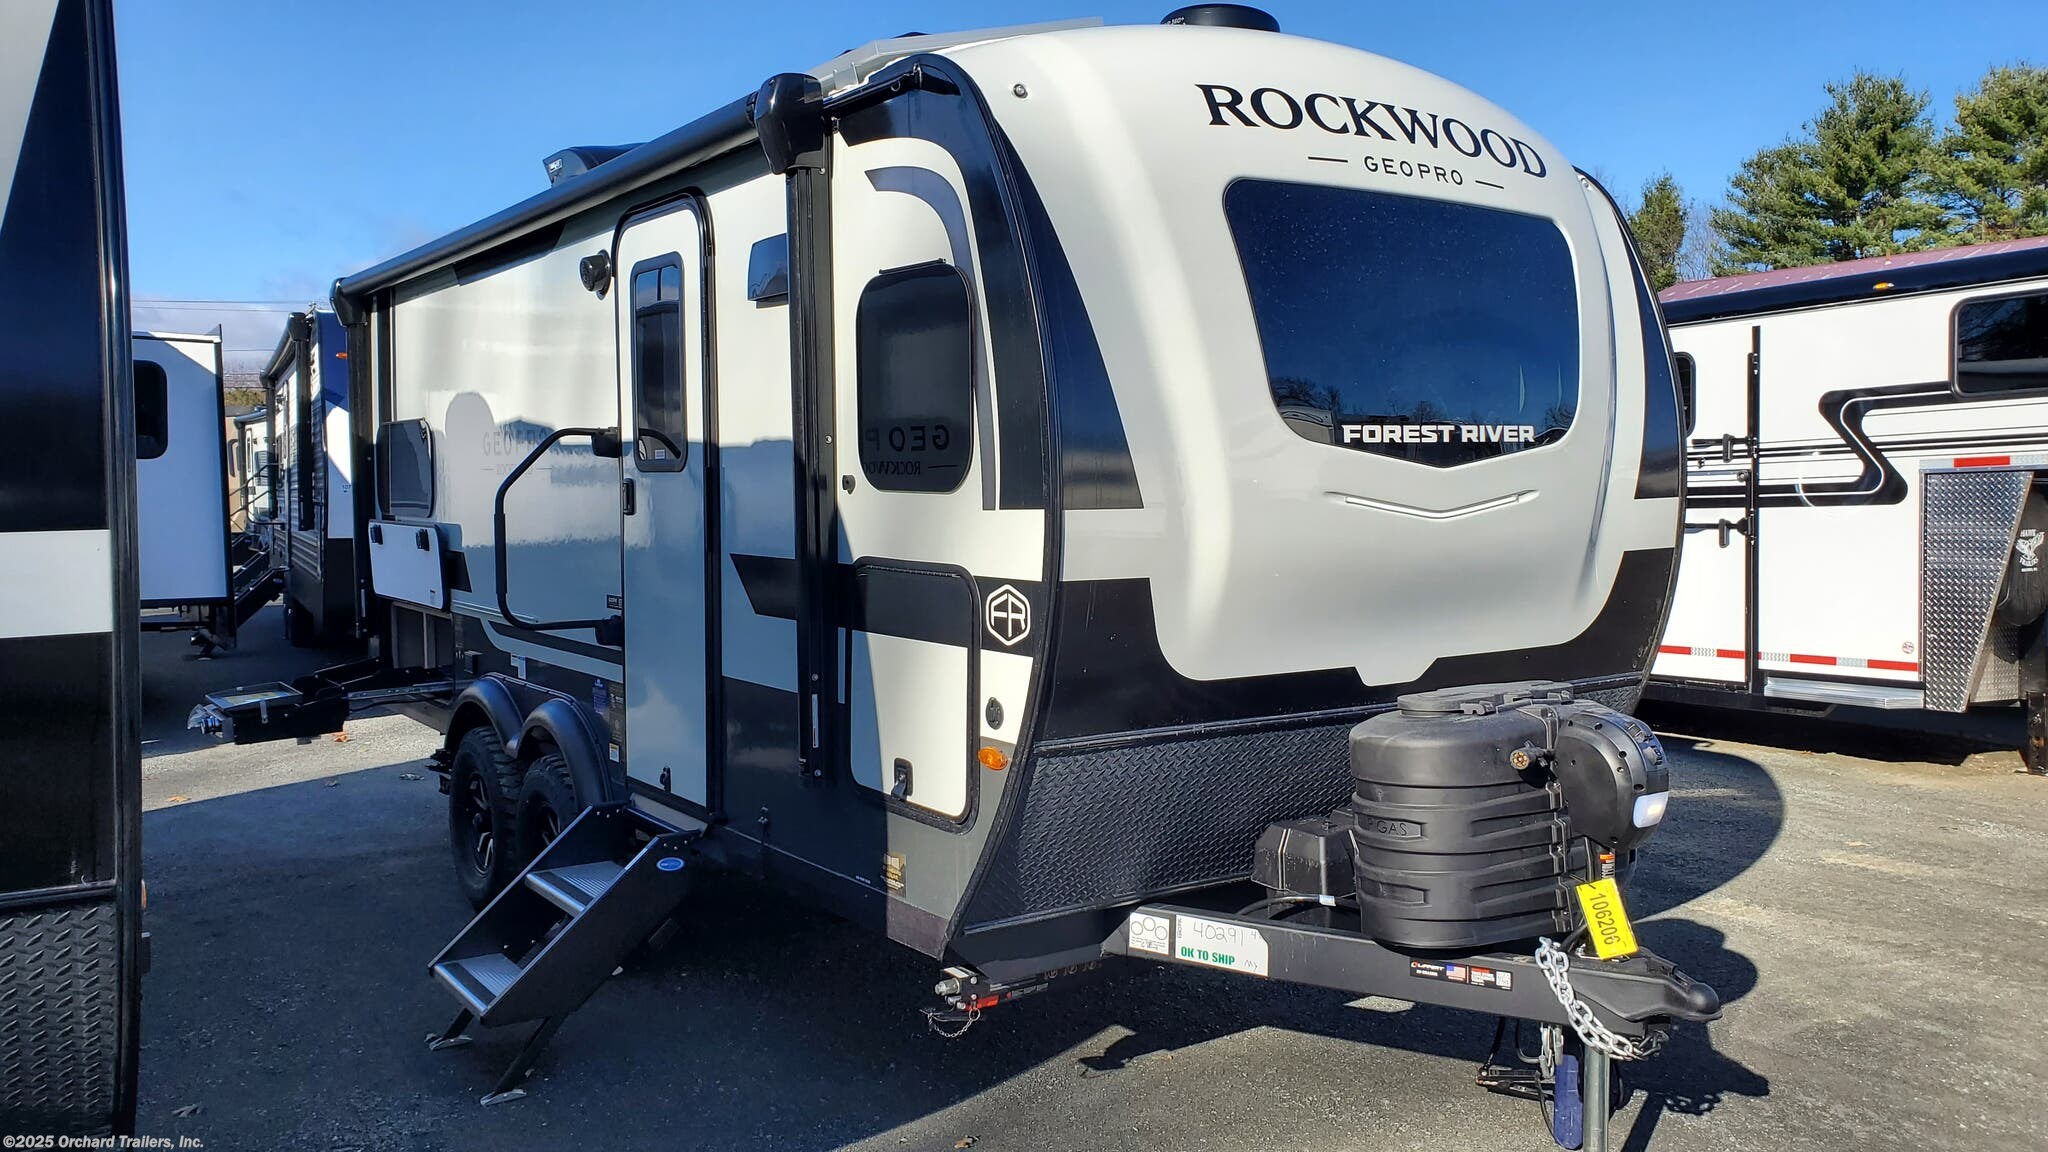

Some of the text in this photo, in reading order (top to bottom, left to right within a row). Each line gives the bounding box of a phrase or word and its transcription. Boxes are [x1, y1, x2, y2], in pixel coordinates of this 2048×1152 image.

[1195, 84, 1546, 178] ROCKWOOD
[1364, 155, 1463, 186] GEOPRO
[1341, 424, 1535, 443] FOREST RIVER
[1376, 820, 1407, 836] GAS
[1589, 893, 1621, 945] 106206
[1181, 946, 1235, 965] OK TO SHIP
